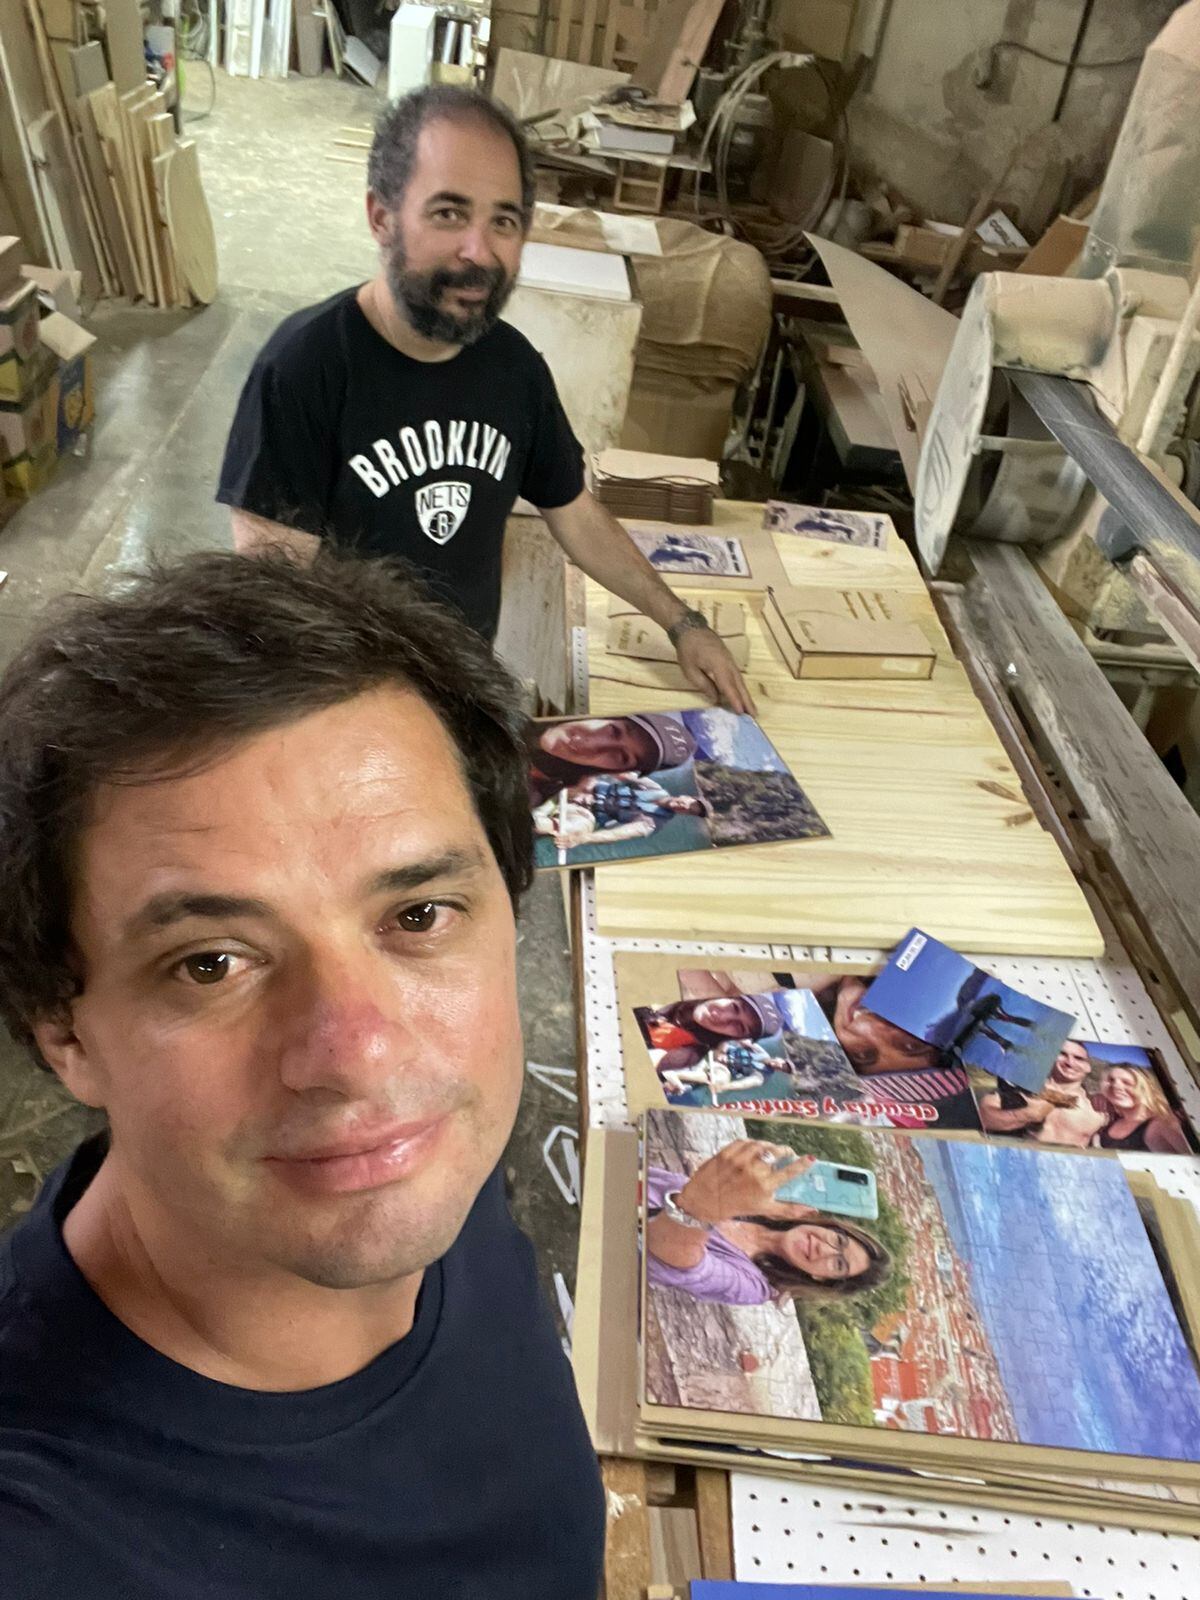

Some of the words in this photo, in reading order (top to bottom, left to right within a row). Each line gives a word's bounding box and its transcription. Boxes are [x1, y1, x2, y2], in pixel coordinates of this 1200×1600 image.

[348, 420, 511, 498] BROOKLYN
[419, 485, 469, 512] NETS
[822, 1095, 837, 1114] y
[841, 1102, 940, 1121] Claudia
